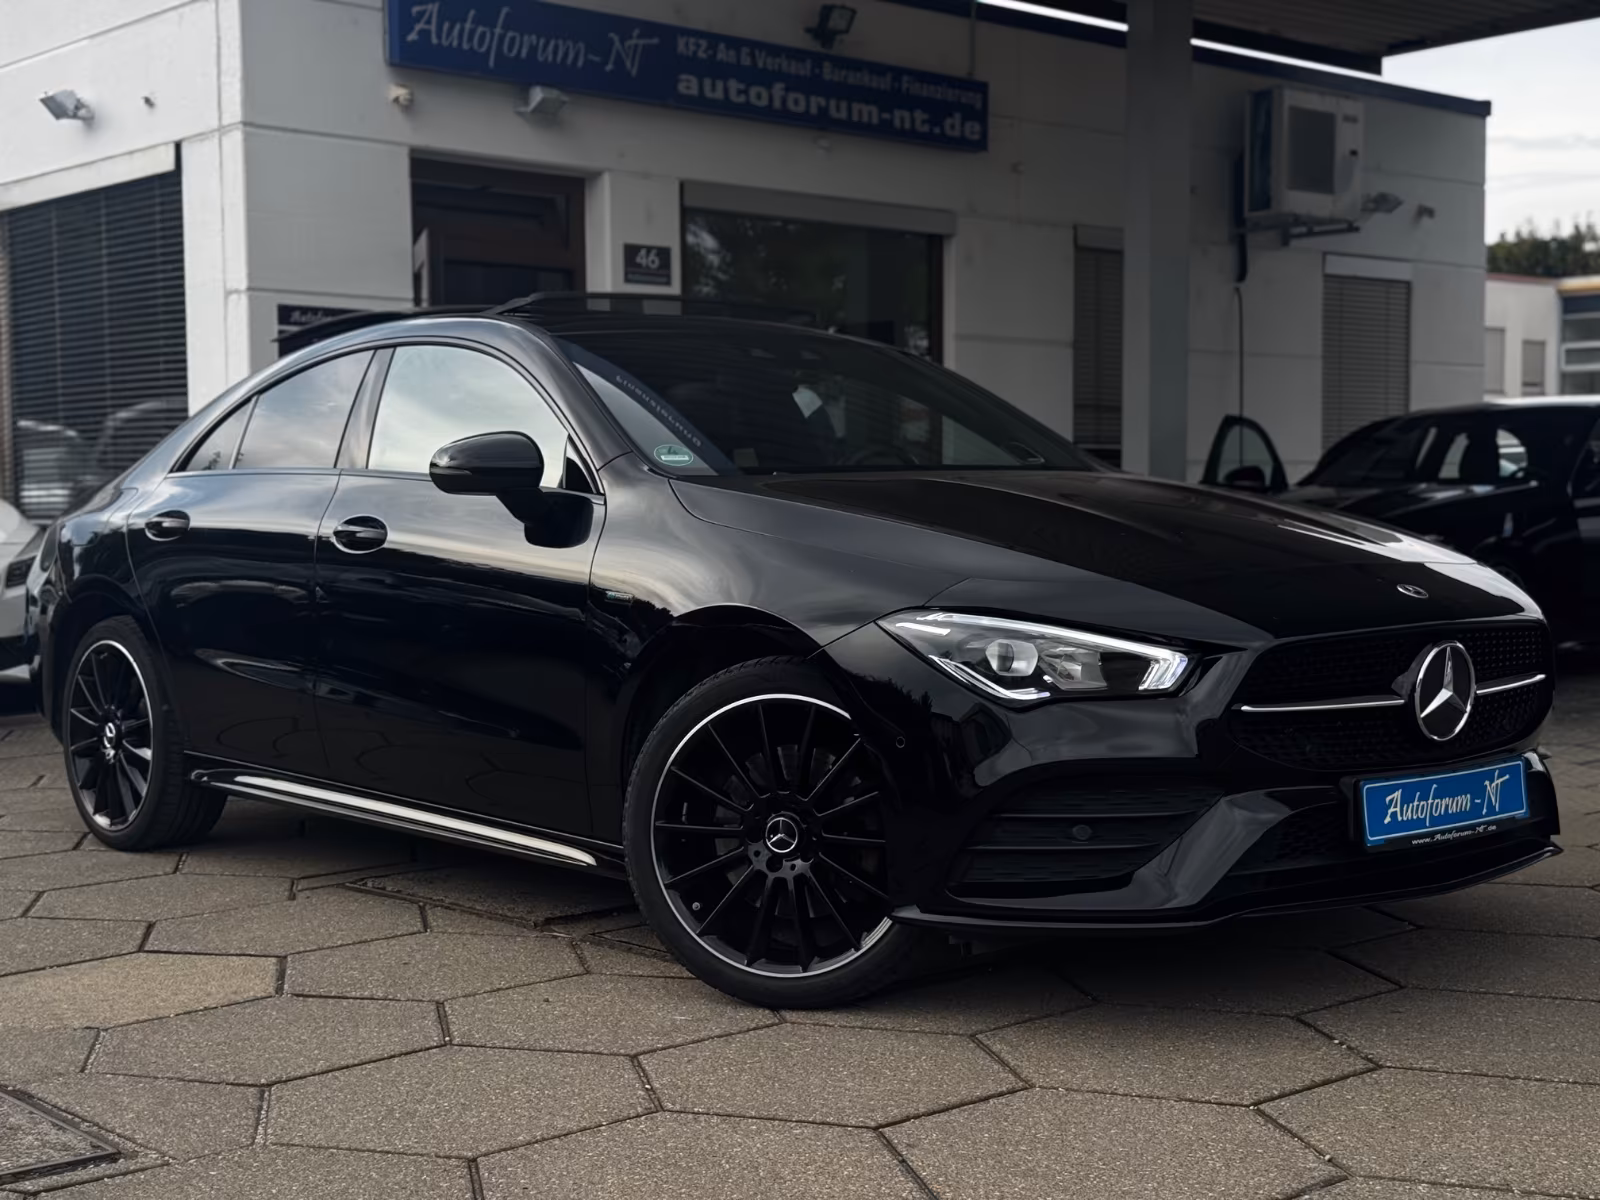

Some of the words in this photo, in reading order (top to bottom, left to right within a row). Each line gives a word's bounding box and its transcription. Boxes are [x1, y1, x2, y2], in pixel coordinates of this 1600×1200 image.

[405, 0, 659, 78] Autoforum-NT
[676, 73, 981, 140] autoforum-nt.de
[716, 42, 738, 65] An
[755, 48, 812, 77] Verkauf
[902, 75, 982, 109] Finanzierung
[635, 247, 660, 269] 46
[1411, 823, 1497, 846] www.Autoforum-NT.de
